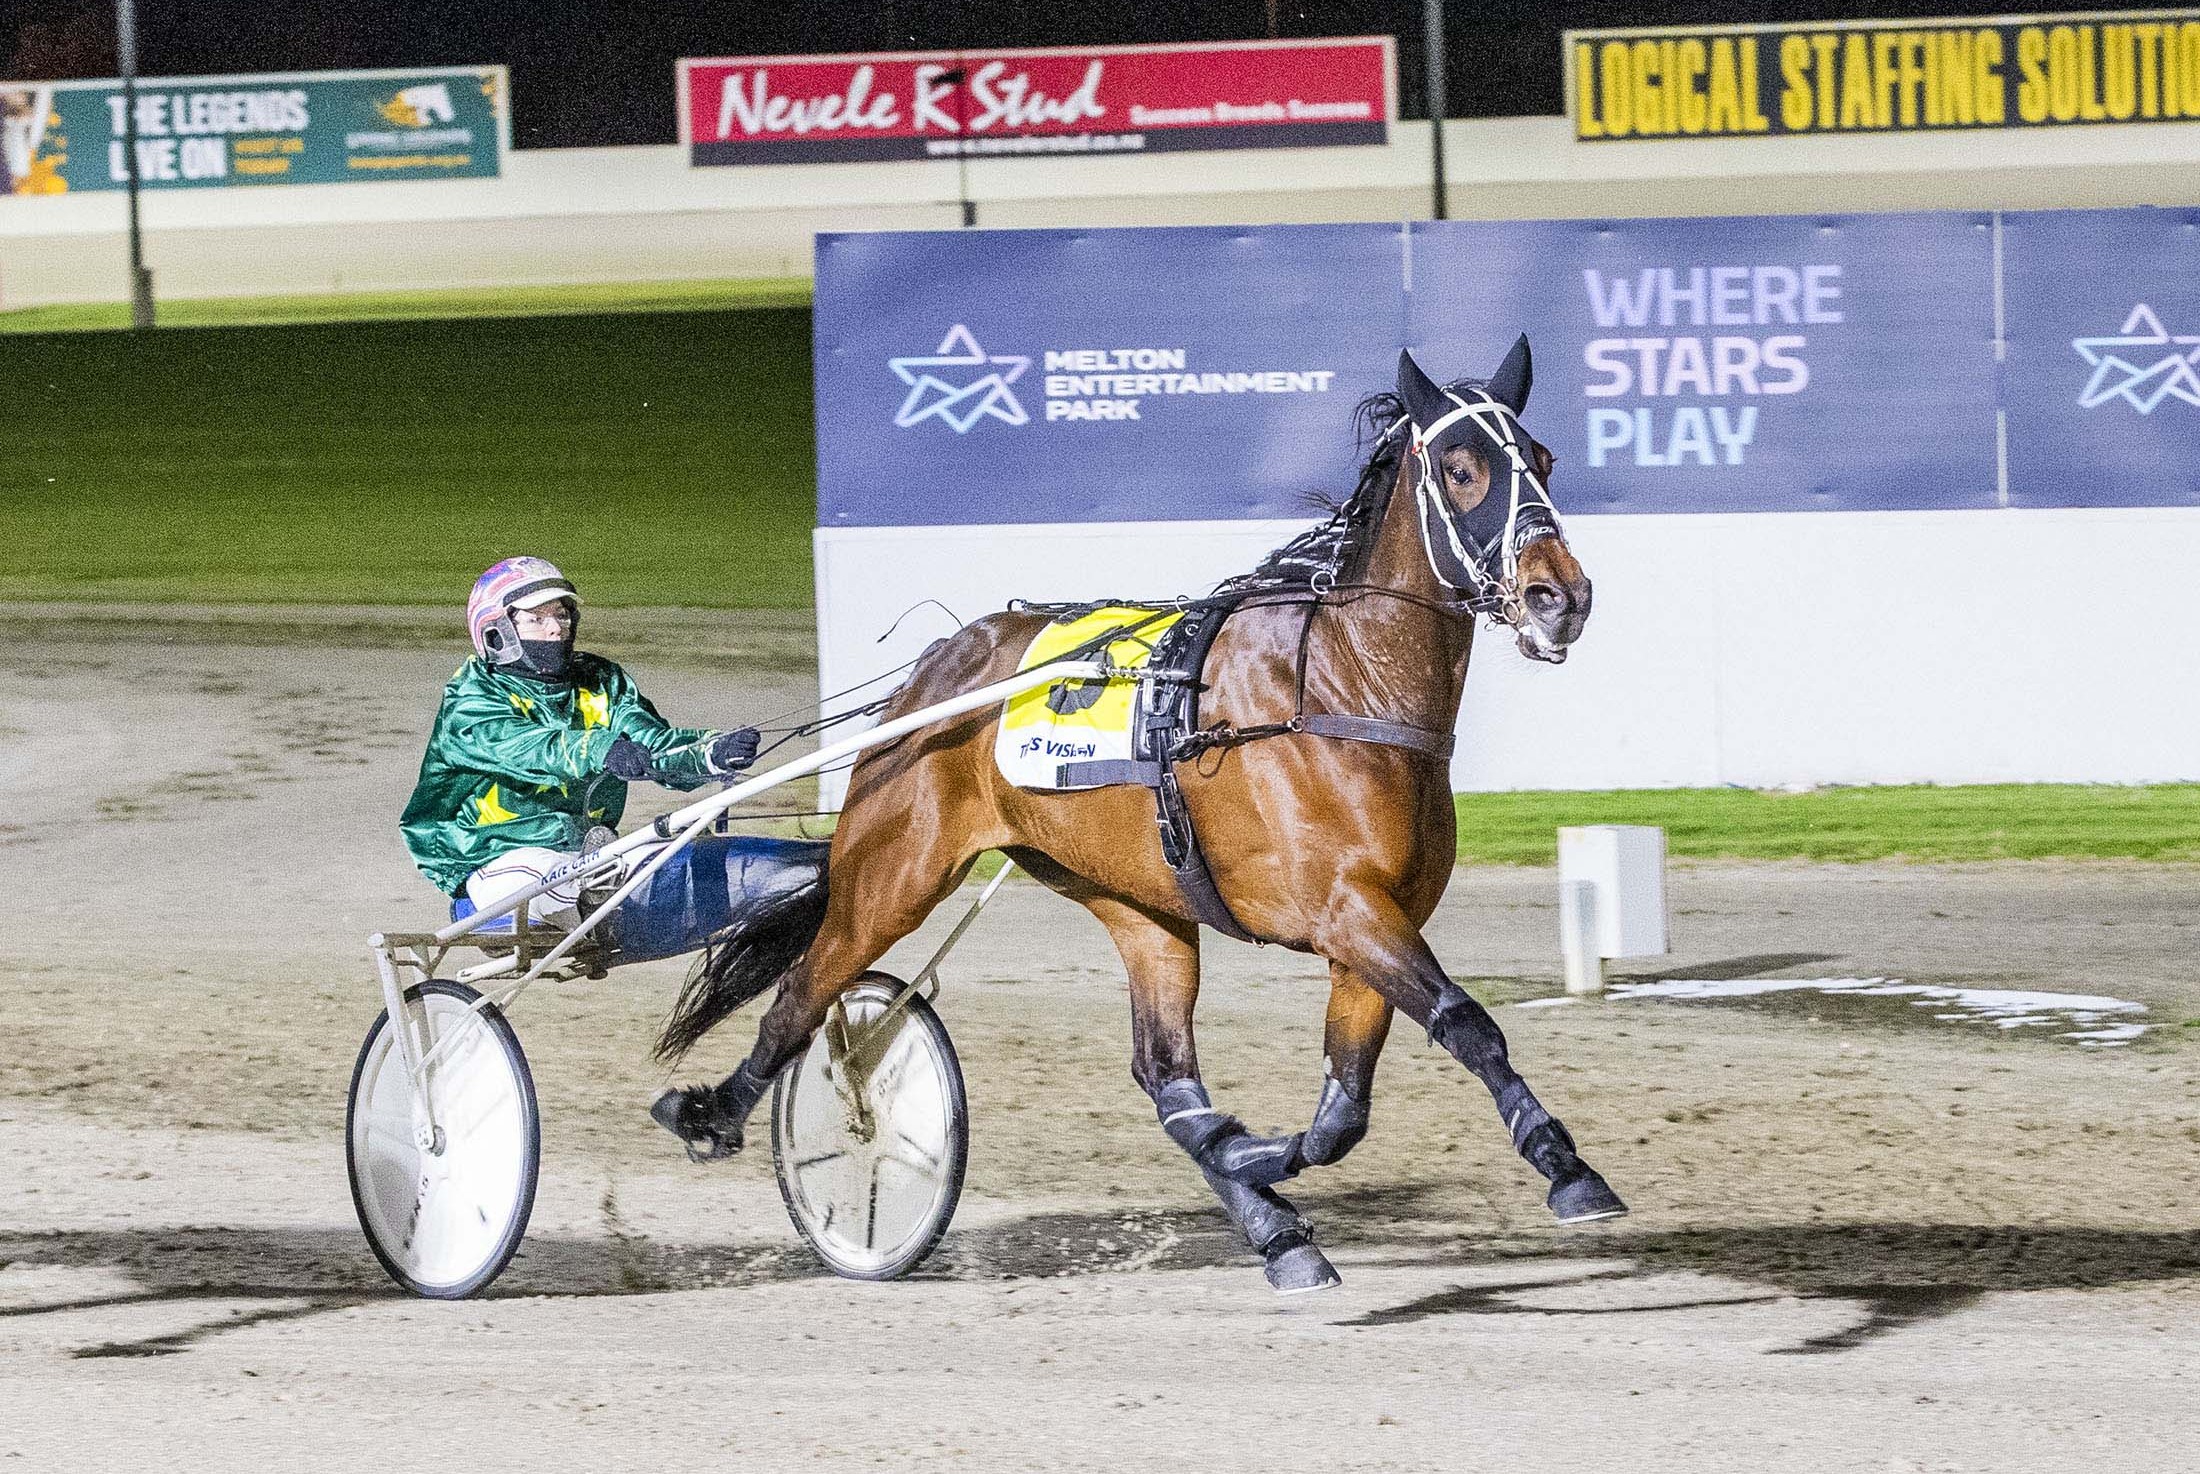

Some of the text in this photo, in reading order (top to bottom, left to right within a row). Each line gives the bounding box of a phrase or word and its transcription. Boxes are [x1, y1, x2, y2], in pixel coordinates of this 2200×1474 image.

[717, 65, 898, 138] Nevele
[969, 59, 1105, 131] Stud
[1577, 37, 1769, 138] LOGICAL
[1780, 28, 2005, 130] STAFFING
[106, 90, 309, 136] THE LEGENDS
[108, 138, 178, 182] LVE
[180, 138, 227, 178] ON
[1583, 264, 1845, 327] WHERE
[1044, 349, 1185, 371] MELTON
[1045, 371, 1335, 396] ENTERTAINMENT
[1583, 335, 1809, 396] STARS
[1046, 400, 1140, 421] PARK
[1588, 406, 1758, 467] PLAY
